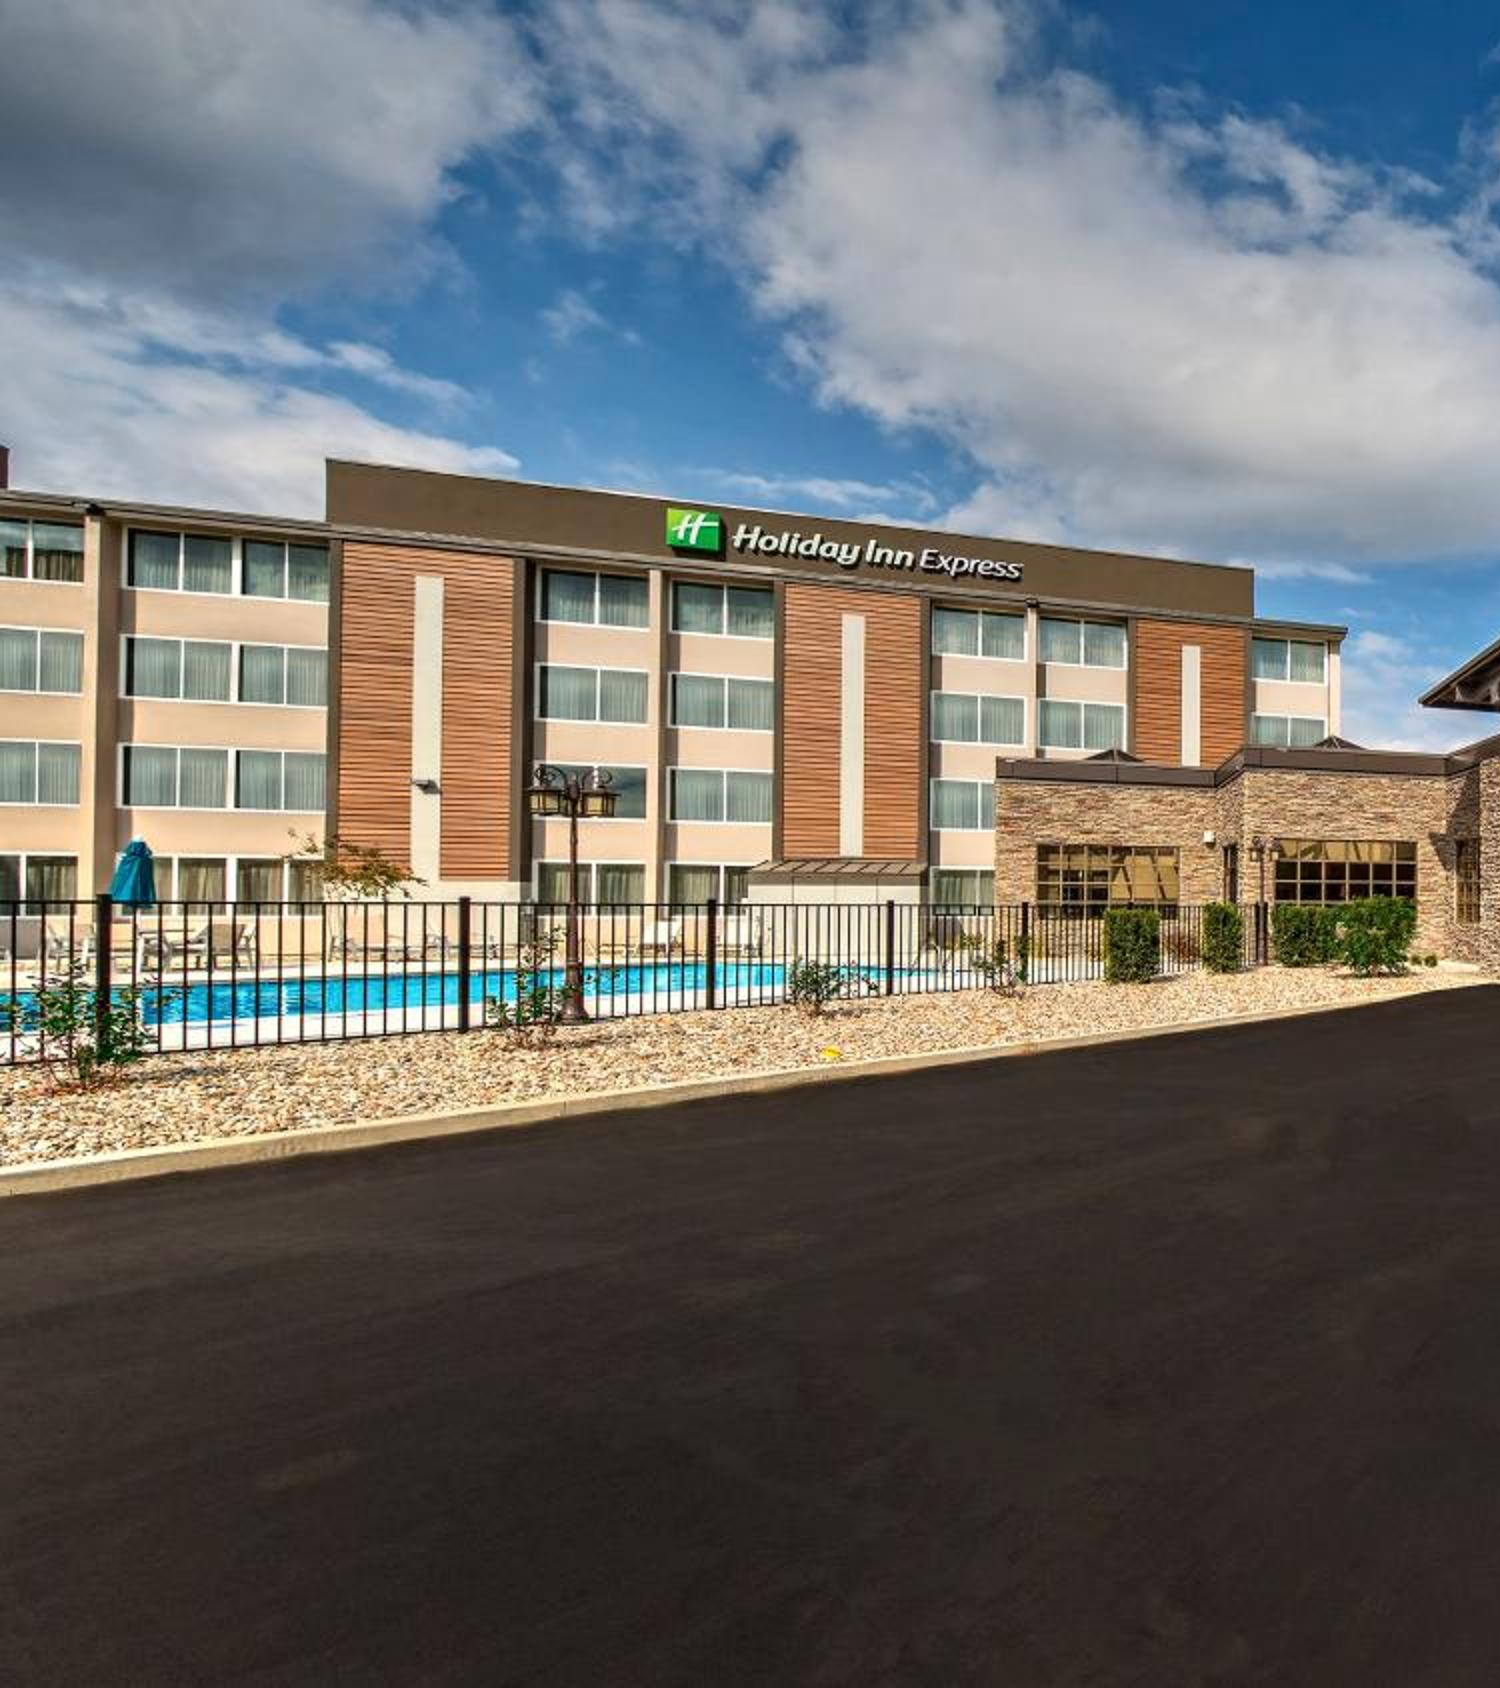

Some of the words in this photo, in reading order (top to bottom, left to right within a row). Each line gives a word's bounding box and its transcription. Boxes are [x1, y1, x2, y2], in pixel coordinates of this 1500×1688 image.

[732, 523, 860, 565] Holiday
[865, 539, 915, 567] Inn
[919, 549, 1024, 579] Express
